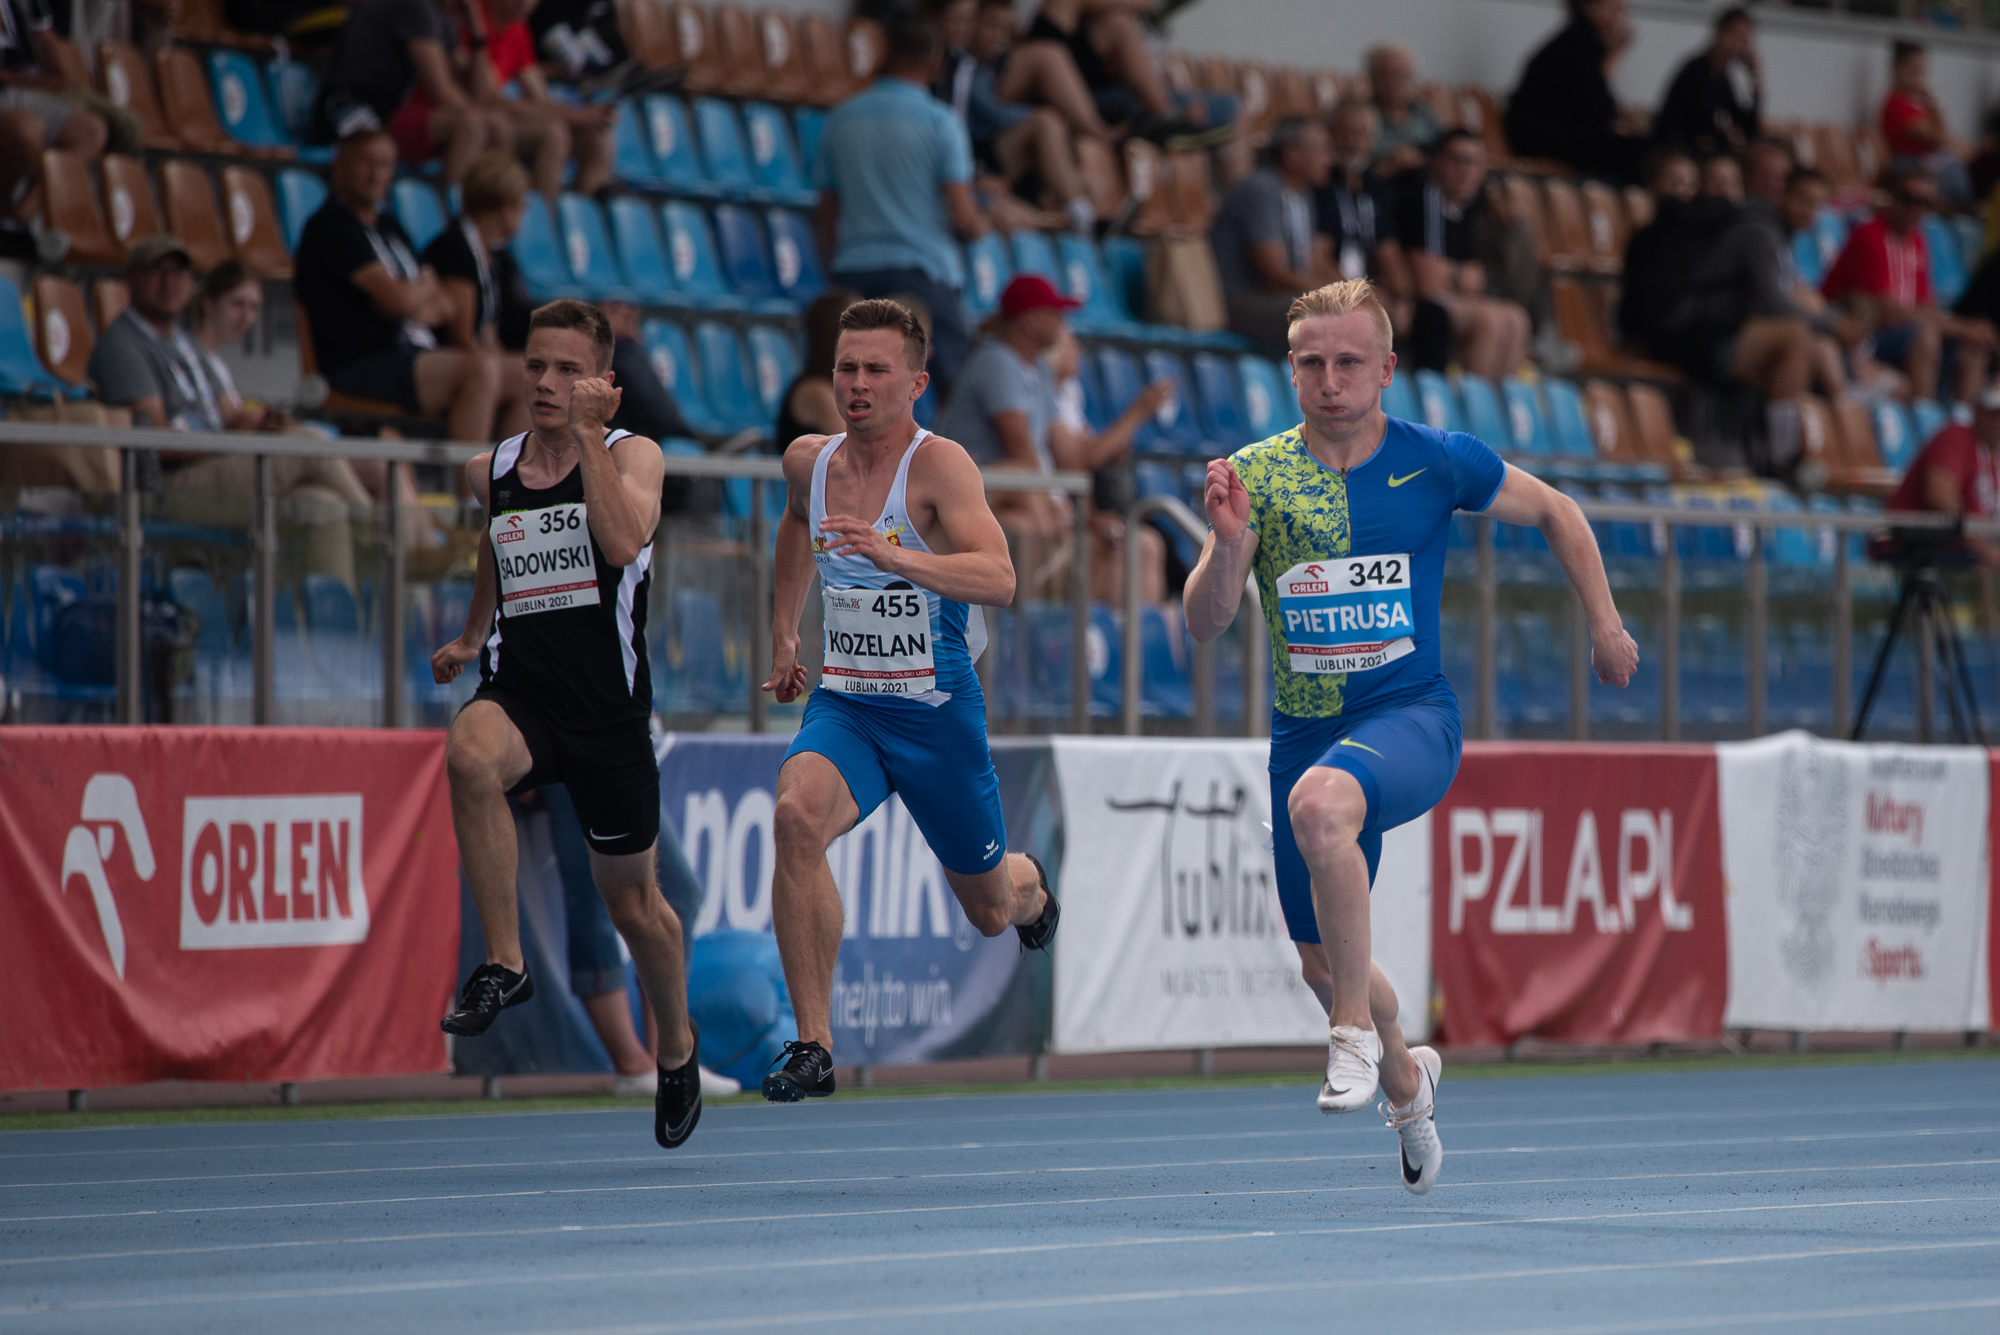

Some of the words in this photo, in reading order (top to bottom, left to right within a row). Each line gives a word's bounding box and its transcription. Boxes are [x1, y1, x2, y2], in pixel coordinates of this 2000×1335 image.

[539, 508, 580, 534] 356
[498, 531, 524, 543] ORLEN
[500, 545, 590, 580] SADOWSKI
[1348, 559, 1403, 587] 342
[1292, 582, 1327, 594] ORLEN
[515, 598, 547, 613] LUBLIN
[548, 595, 573, 607] 2021
[871, 594, 920, 618] 455
[1285, 601, 1410, 633] PIETRUSA
[829, 630, 926, 657] KOZELAN
[1320, 646, 1369, 655] MISTRZOSTWA
[1315, 657, 1356, 671] LUBLIN
[1360, 652, 1387, 668] 2021
[844, 680, 878, 692] LUBLIN
[881, 682, 908, 693] 2021
[190, 818, 354, 927] ORLEN
[1449, 807, 1694, 935] PZLA.PL
